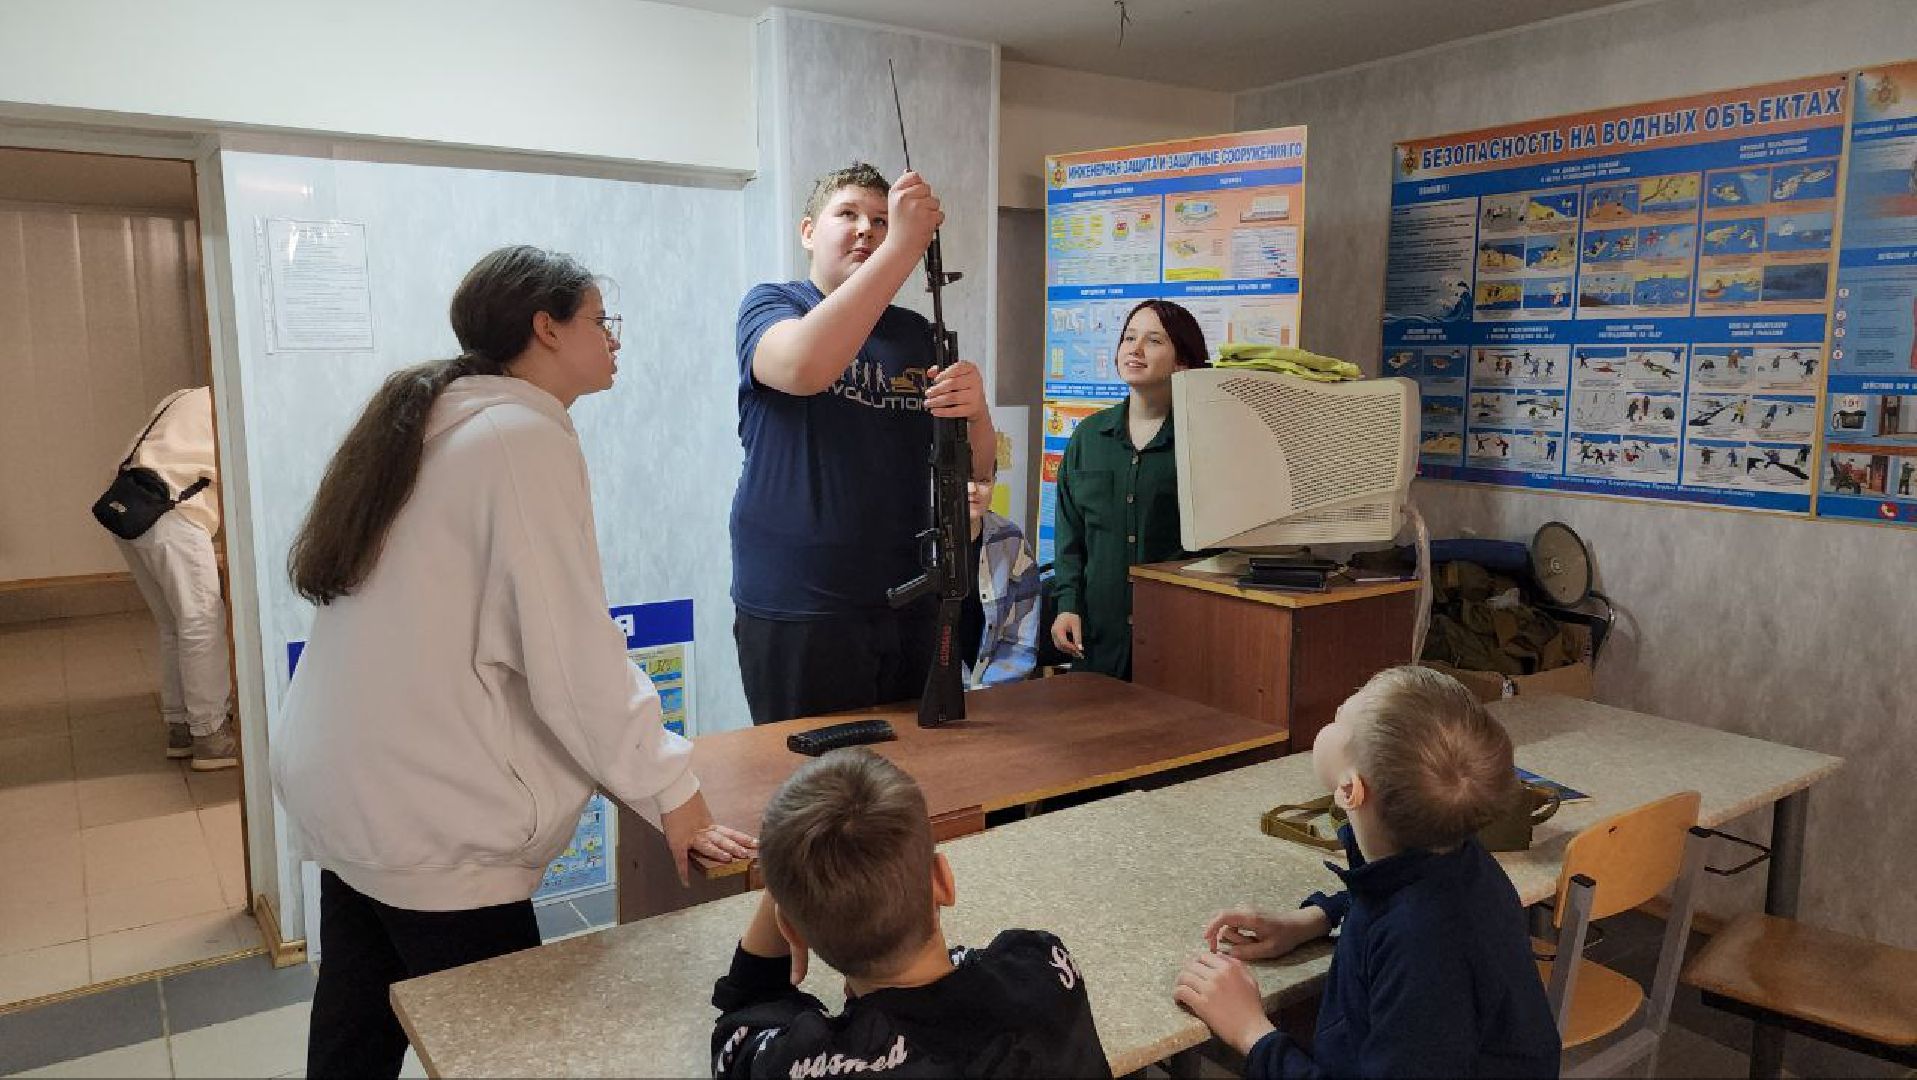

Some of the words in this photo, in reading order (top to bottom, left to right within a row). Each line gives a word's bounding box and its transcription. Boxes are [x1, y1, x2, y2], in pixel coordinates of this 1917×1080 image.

[1422, 131, 1563, 170] БЕЗОПАСНОСТЬ
[1570, 125, 1597, 149] НА
[1602, 111, 1697, 144] ВОДНЫХ
[1704, 89, 1843, 130] ОБЪЕКТАХ
[1068, 158, 1121, 180] ИНЖЕНЕРНАЯ
[1123, 155, 1158, 174] ЗАЩИТА
[1159, 155, 1166, 170] И
[1168, 150, 1219, 170] ЗАЩИТНЫЕ
[1221, 144, 1287, 165] СООРУЖЕНИЯ
[1288, 143, 1302, 157] ГО
